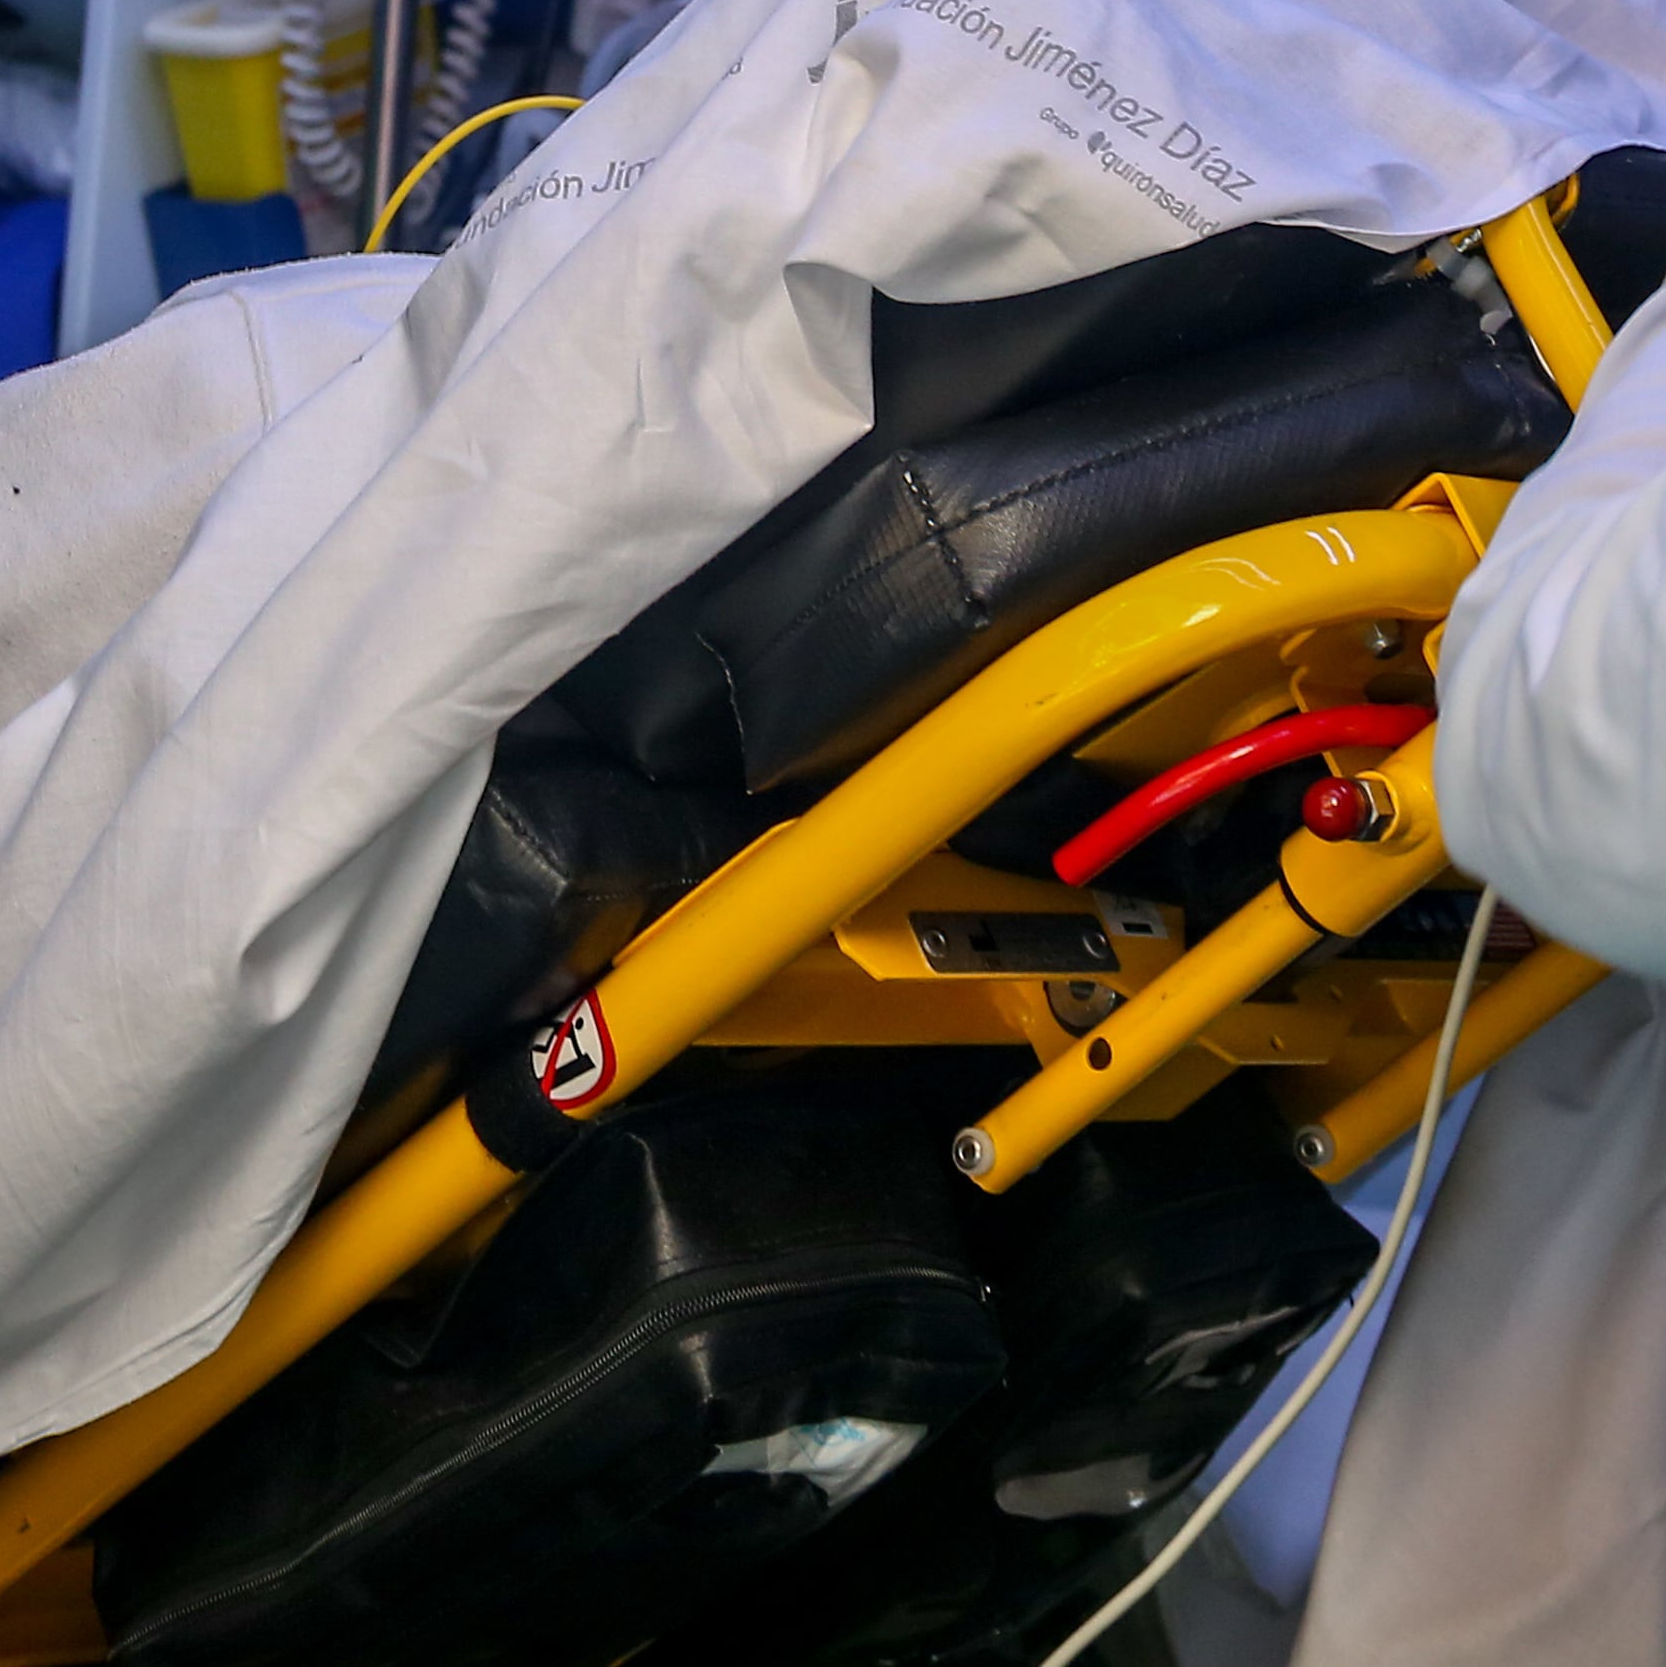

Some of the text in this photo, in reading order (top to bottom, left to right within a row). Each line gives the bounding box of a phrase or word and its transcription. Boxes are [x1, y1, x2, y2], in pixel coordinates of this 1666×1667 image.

[1005, 26, 1165, 140] Jiménez
[1158, 120, 1258, 203] Díaz
[1039, 106, 1080, 140] Grupo
